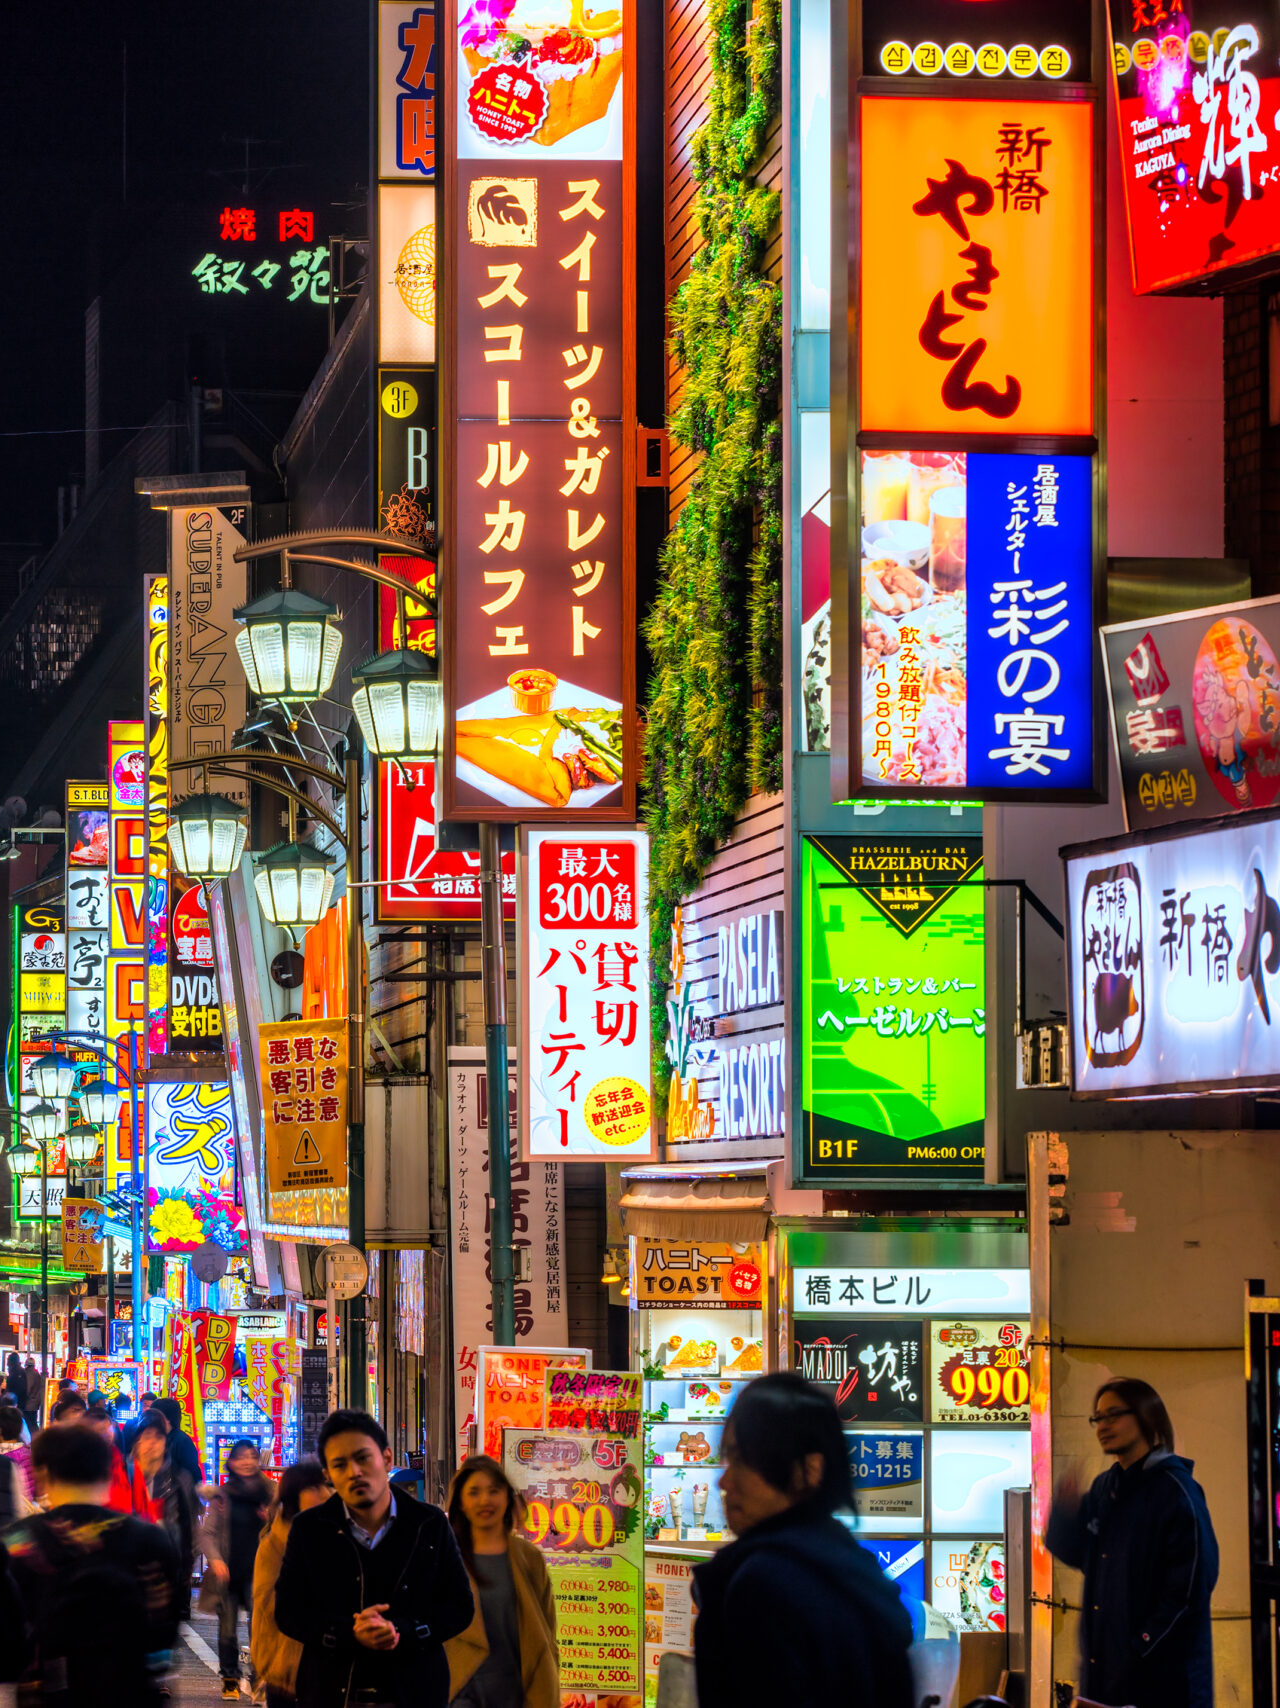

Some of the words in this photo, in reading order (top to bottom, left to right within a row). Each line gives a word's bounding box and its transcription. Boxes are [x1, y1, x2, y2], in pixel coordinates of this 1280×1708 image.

[884, 43, 1065, 75] 삼겹살전문점
[495, 72, 533, 99] 名物
[473, 87, 536, 125] ハニトー
[476, 105, 502, 119] HONEY
[502, 115, 525, 128] TOAST
[478, 114, 500, 127] SINCE
[500, 122, 517, 134] 1993
[1162, 124, 1191, 146] Dining
[994, 123, 1051, 215] 新橋
[1135, 152, 1176, 178] KAGUYA
[219, 207, 314, 242] 焼肉
[191, 246, 340, 305] 叙々苑
[913, 159, 1021, 419] やきとん
[391, 387, 410, 413] 3F
[558, 178, 610, 656] スイーツ&ガレット
[476, 262, 529, 657] スコールカフェ
[1032, 464, 1060, 528] 居酒屋
[231, 508, 245, 525] 2F
[1005, 481, 1030, 574] シェルター
[988, 579, 1070, 777] 彩の宴
[897, 625, 921, 780] 飲み放題付コース
[558, 848, 620, 878] 最大
[850, 856, 969, 871] HAZELBURN
[852, 846, 912, 854] BRASSERIE
[920, 846, 937, 854] and
[945, 846, 967, 855] BAR
[545, 883, 611, 922] 300
[612, 882, 632, 922] 名様
[902, 902, 919, 912] 1998
[1096, 882, 1127, 918] 新橋
[1159, 888, 1233, 988] 新橋
[718, 909, 780, 1012] PASELA
[23, 991, 65, 1001] MIRAGE
[591, 940, 639, 1048] 貸切
[836, 976, 976, 995] レストラン&バー
[268, 1037, 338, 1065] 悪質な
[537, 940, 587, 1147] パーティー
[270, 1066, 337, 1095] 客引き
[273, 1096, 340, 1124] に注意
[595, 1088, 634, 1107] 忘年会
[592, 1100, 646, 1126] 歓送迎会
[818, 1140, 858, 1158] B1F
[907, 1147, 957, 1159] PM6:00
[25, 1187, 65, 1206] 天照
[643, 1248, 733, 1271] ハニトー
[644, 1276, 723, 1294] TOAST
[734, 1270, 758, 1282] パセラ
[735, 1279, 753, 1290] 名物
[805, 1274, 932, 1307] 橋本ビル
[238, 1317, 285, 1327] ASABLANCA
[1000, 1325, 1022, 1346] 5F
[950, 1366, 1030, 1407] 990
[594, 1440, 627, 1467] 5F
[656, 1563, 692, 1577] HONEY
